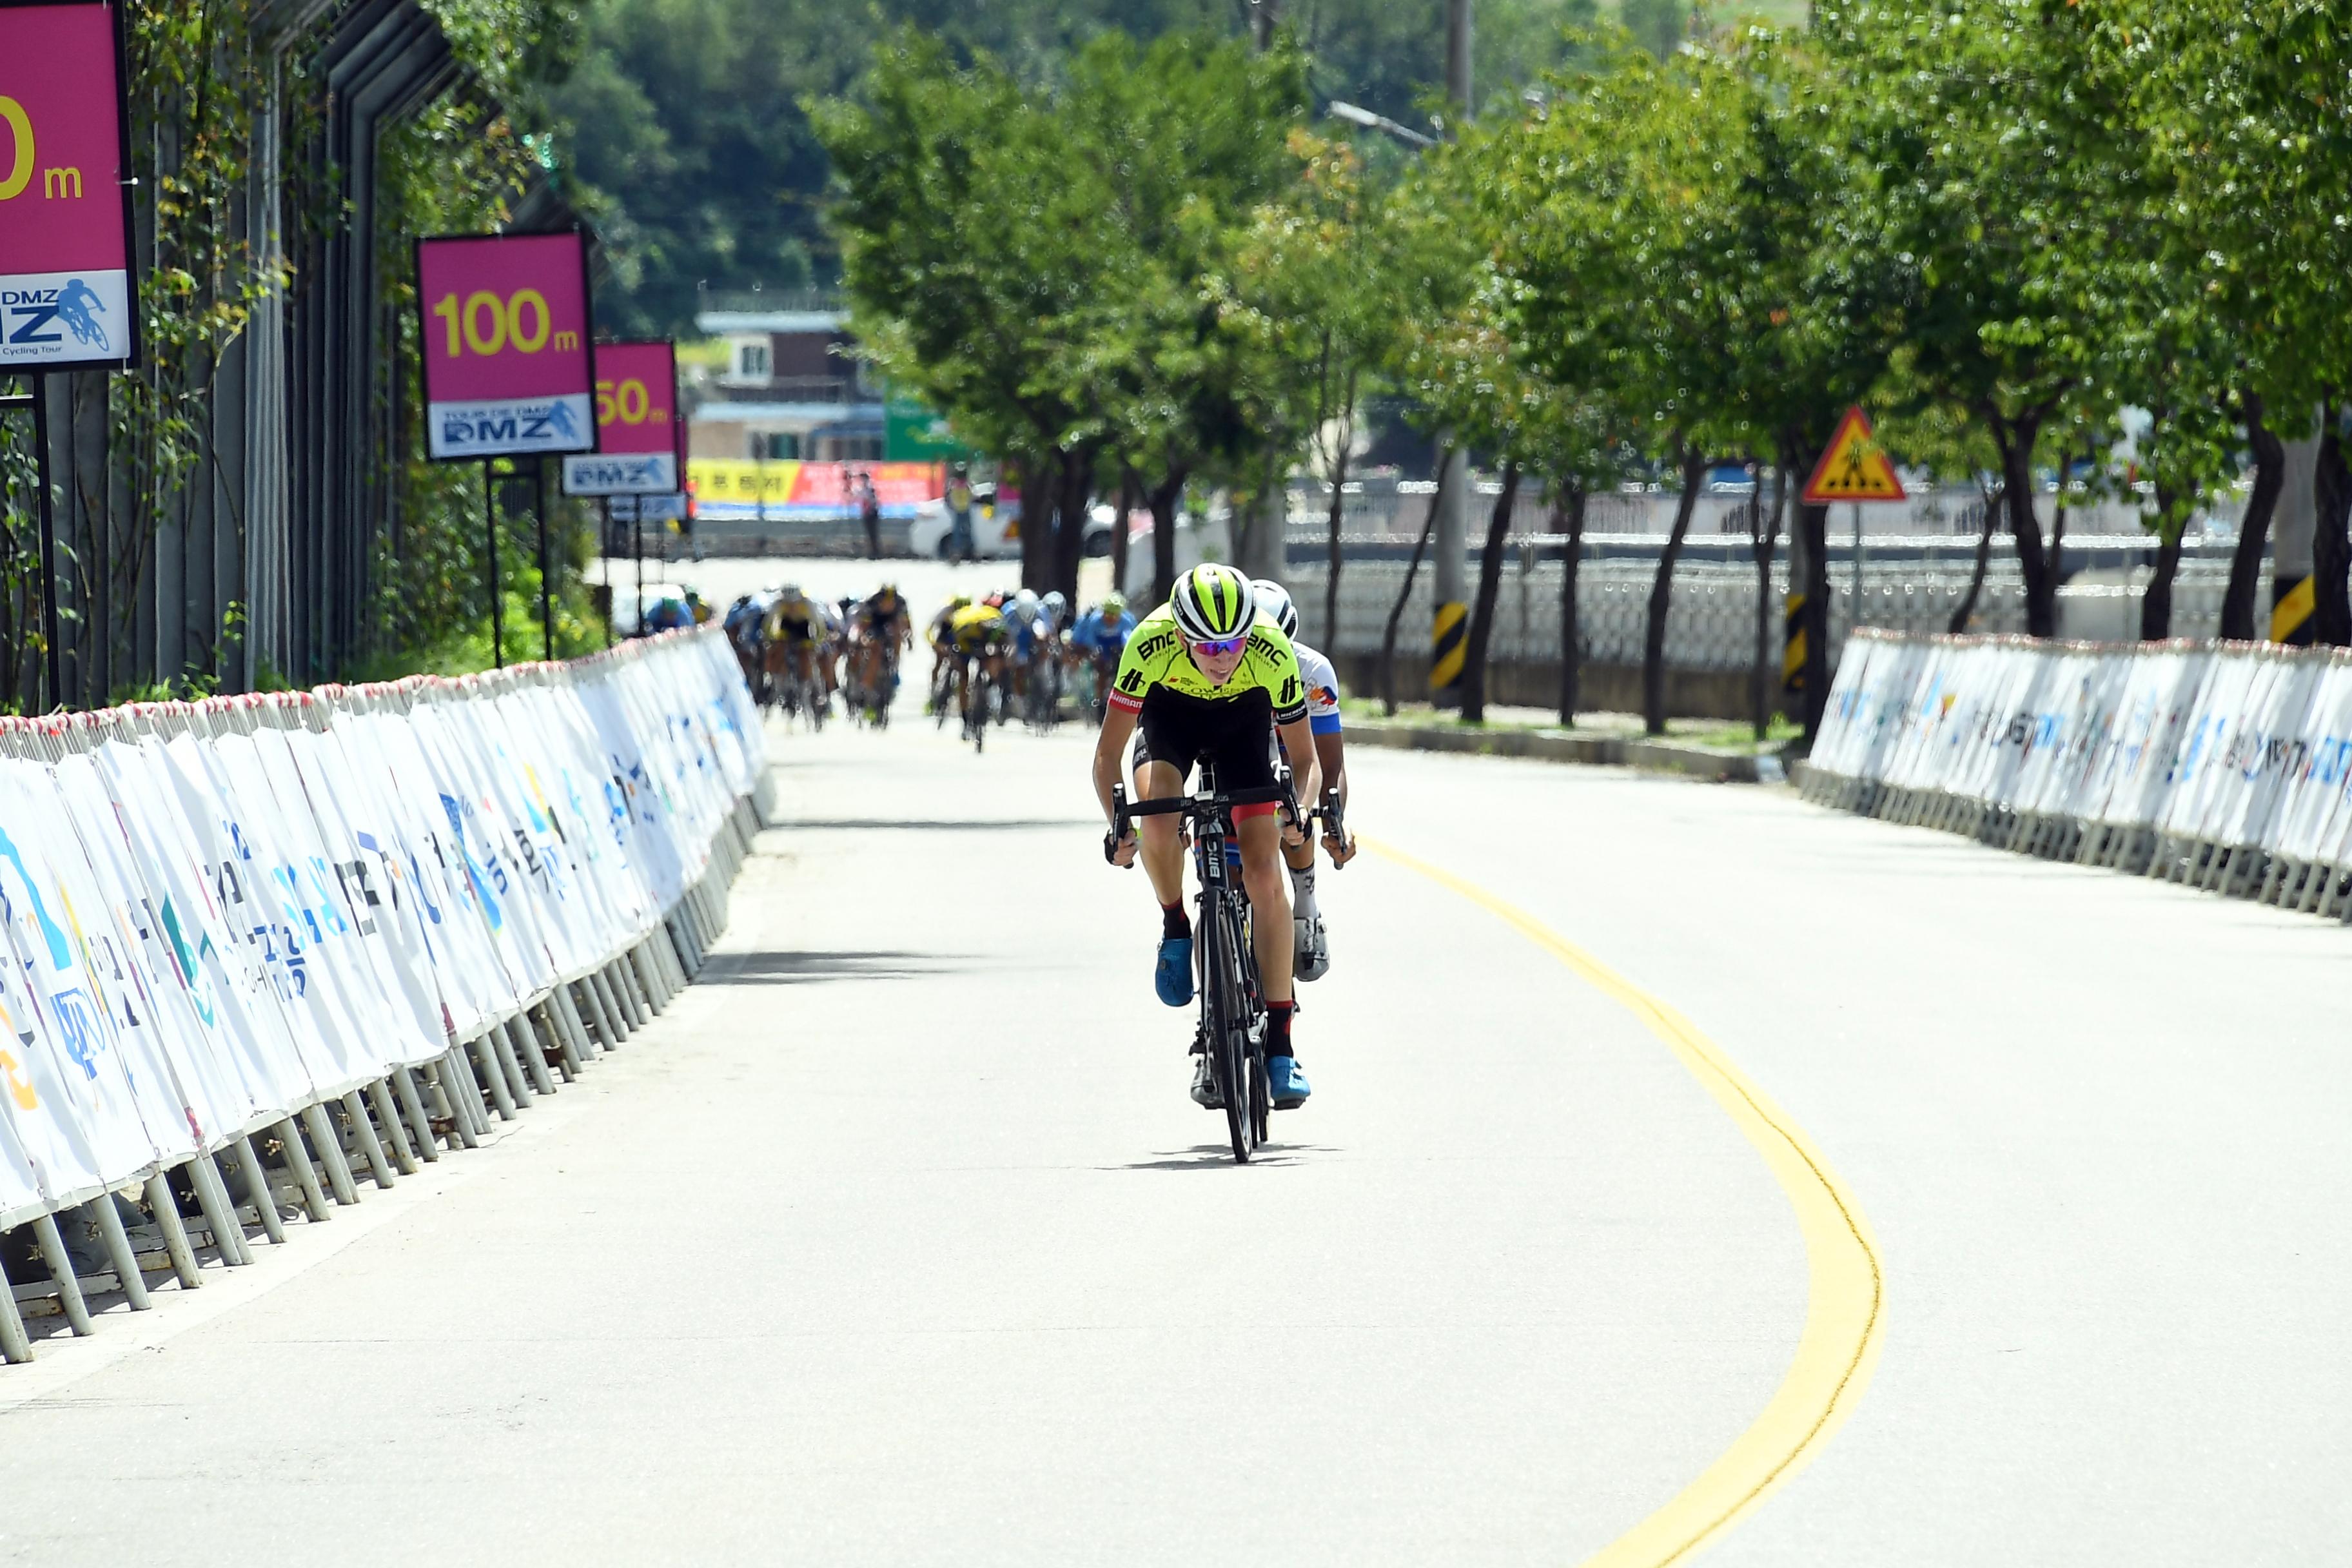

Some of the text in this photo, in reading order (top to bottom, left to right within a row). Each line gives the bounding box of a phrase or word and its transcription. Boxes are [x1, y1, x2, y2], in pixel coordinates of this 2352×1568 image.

[2, 289, 59, 304] DMZ
[0, 306, 62, 344] Z
[3, 347, 37, 355] Cycling
[445, 418, 552, 442] DMZ
[1137, 631, 1175, 661] BMC
[1247, 633, 1288, 667] BMC
[1207, 841, 1220, 878] BMC
